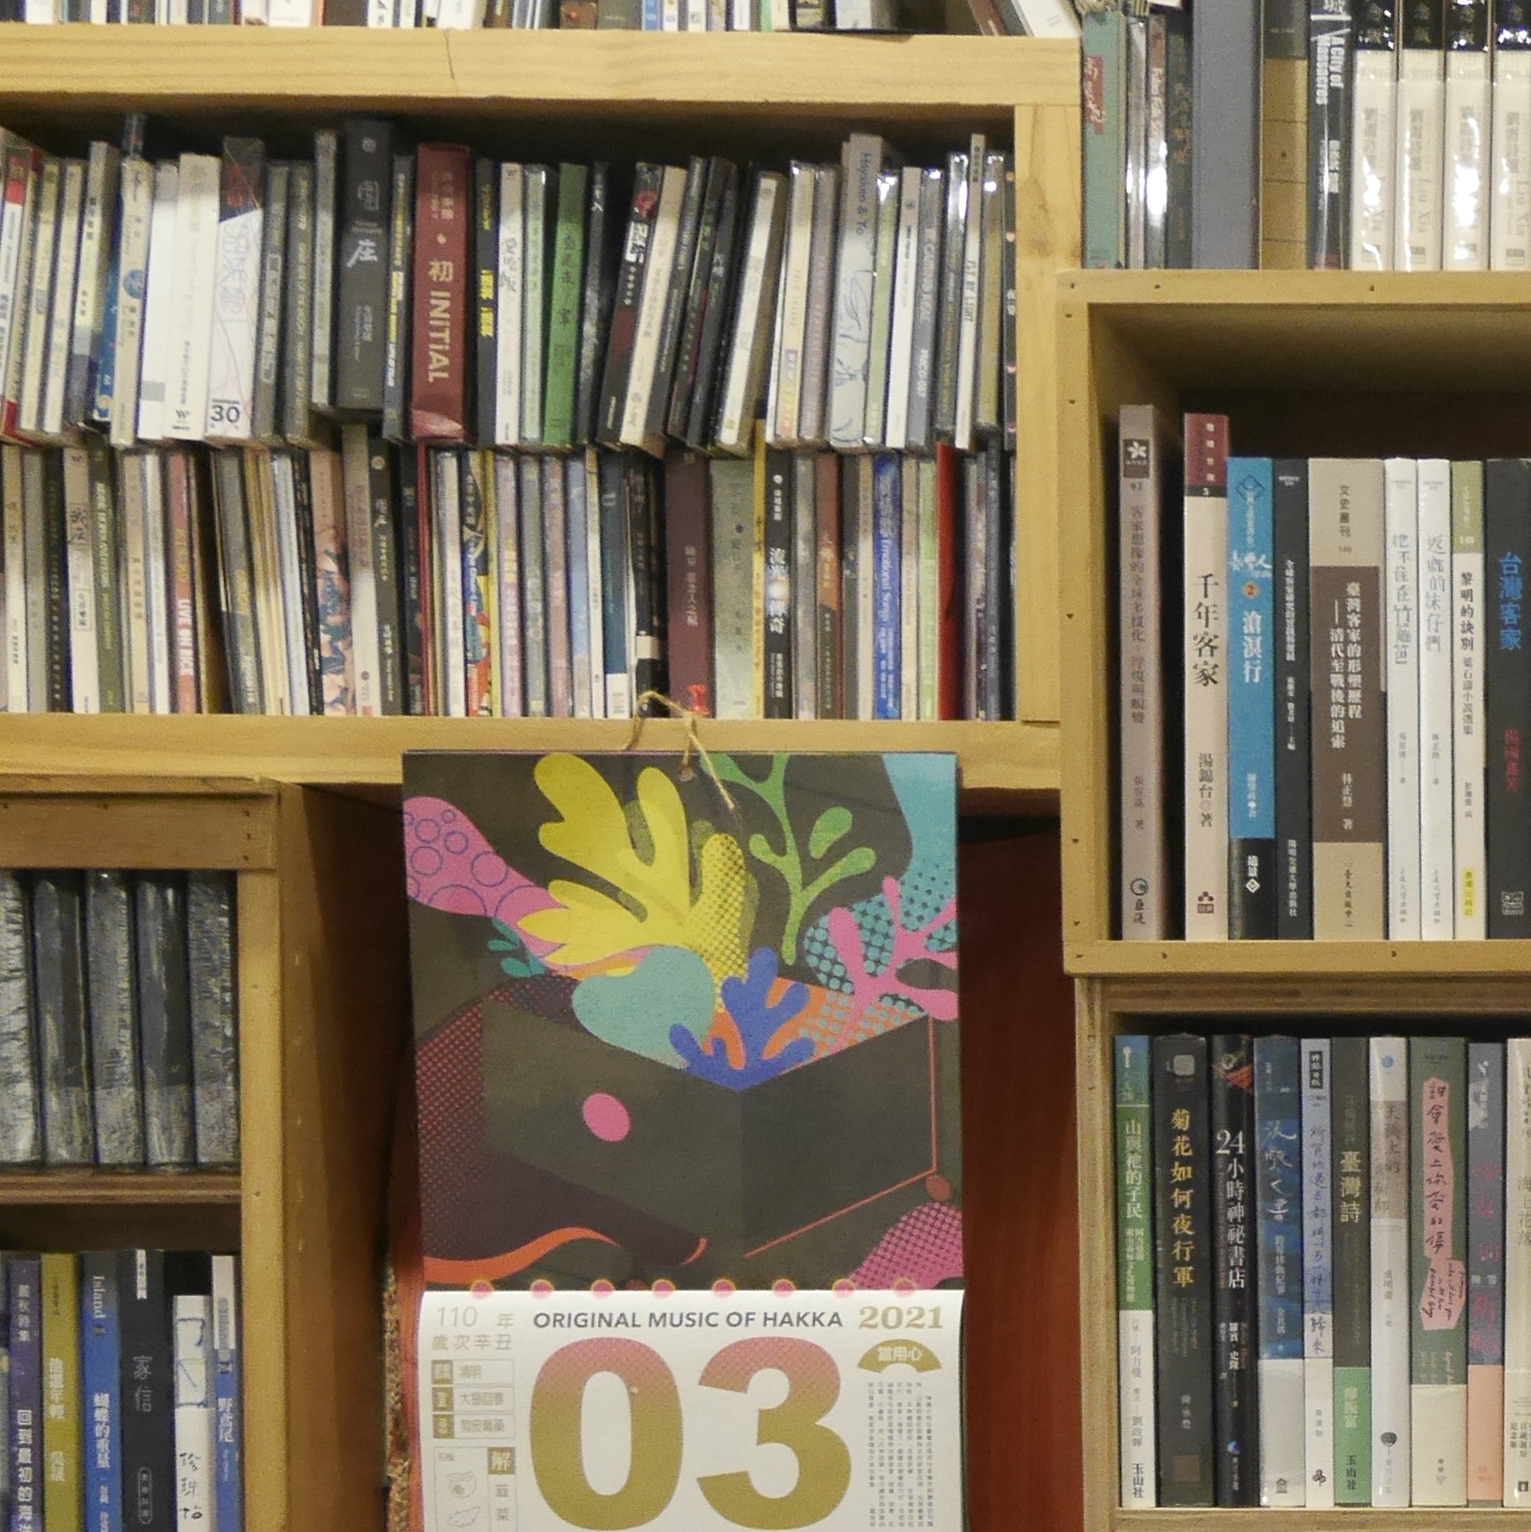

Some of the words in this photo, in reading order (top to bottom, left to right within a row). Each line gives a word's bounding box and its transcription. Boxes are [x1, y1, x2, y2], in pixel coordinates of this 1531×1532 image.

[211, 406, 240, 425] 30
[1460, 571, 1474, 650] 黎明的訣別
[1500, 551, 1523, 650] 台灣客家
[1193, 573, 1219, 687] 千年客家
[1243, 611, 1263, 684] 滄溟行
[1171, 1107, 1195, 1288] 菊花如何夜行軍
[1340, 1150, 1362, 1224] 臺灣詩
[436, 1305, 478, 1328] 110
[497, 1312, 514, 1330] 年
[533, 1311, 641, 1328] ORIGINAL
[648, 1311, 719, 1328] MUSIC
[725, 1311, 757, 1328] OF
[762, 1311, 843, 1328] HAKKA
[858, 1305, 944, 1330] 2021
[431, 1334, 513, 1351] 歲次辛丑
[134, 1355, 152, 1413] 家信
[529, 1336, 852, 1531] 03
[489, 1448, 515, 1474] 解
[1132, 1463, 1144, 1498] 玉山社
[1346, 1454, 1357, 1490] 玉山社
